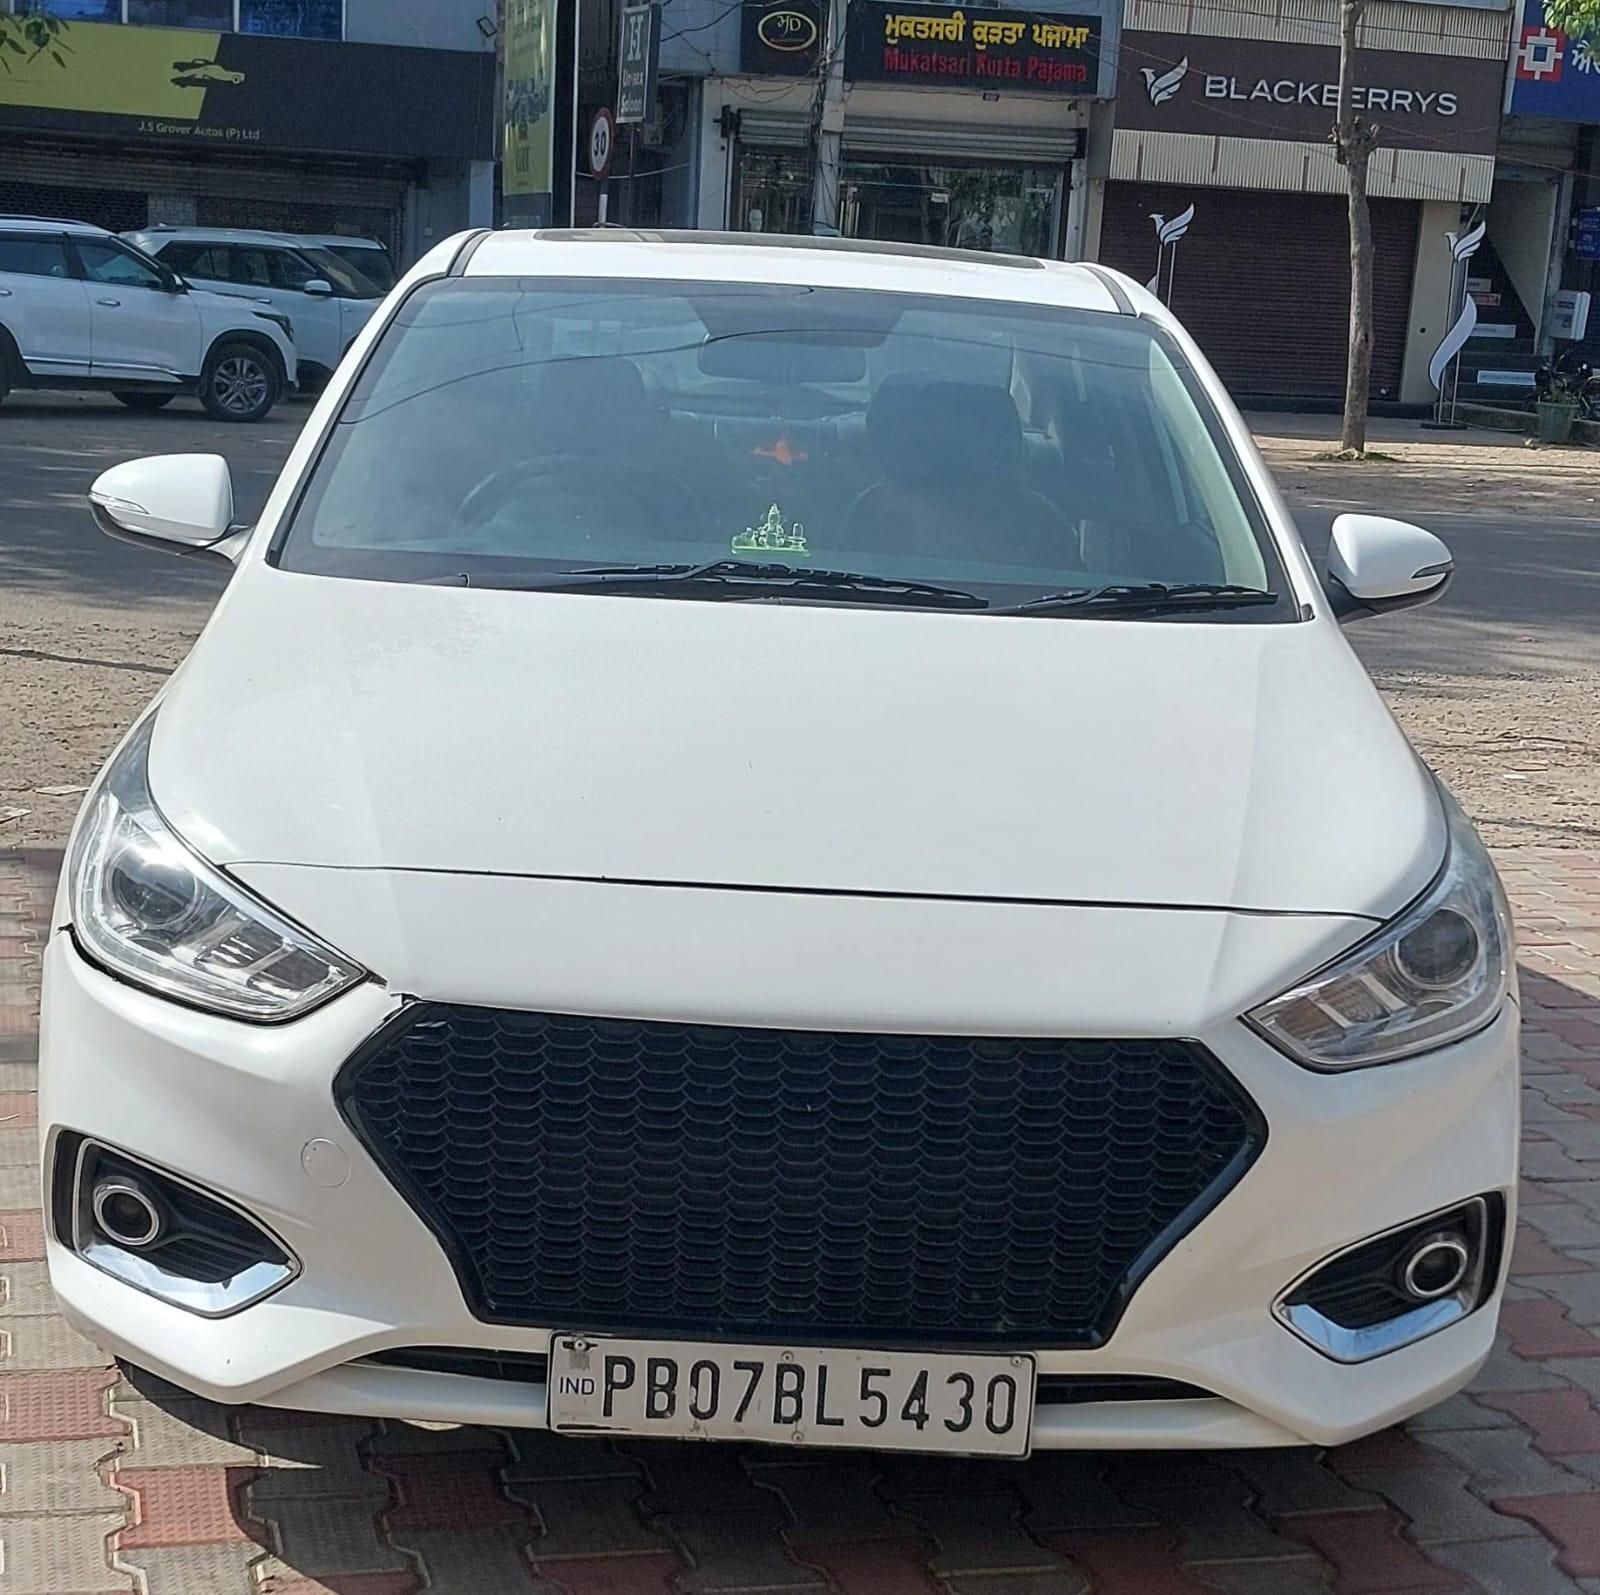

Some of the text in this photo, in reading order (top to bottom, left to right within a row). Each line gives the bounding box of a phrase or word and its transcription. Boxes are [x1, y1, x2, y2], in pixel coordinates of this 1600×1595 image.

[885, 10, 1090, 50] ਮੁਕਤਸਰੀ ਕੁੜਤਾ ਪਜਾਮਾ
[884, 48, 1088, 83] Mukatsari Kurta Pajama
[1204, 75, 1458, 115] BLACKBERRYS
[156, 122, 192, 135] Grover
[194, 126, 224, 138] Autos
[225, 127, 241, 140] (P)
[242, 129, 260, 140] Ltd
[594, 130, 607, 157] 30
[560, 1376, 595, 1395] IND
[601, 1354, 1018, 1435] PB07BL5430
